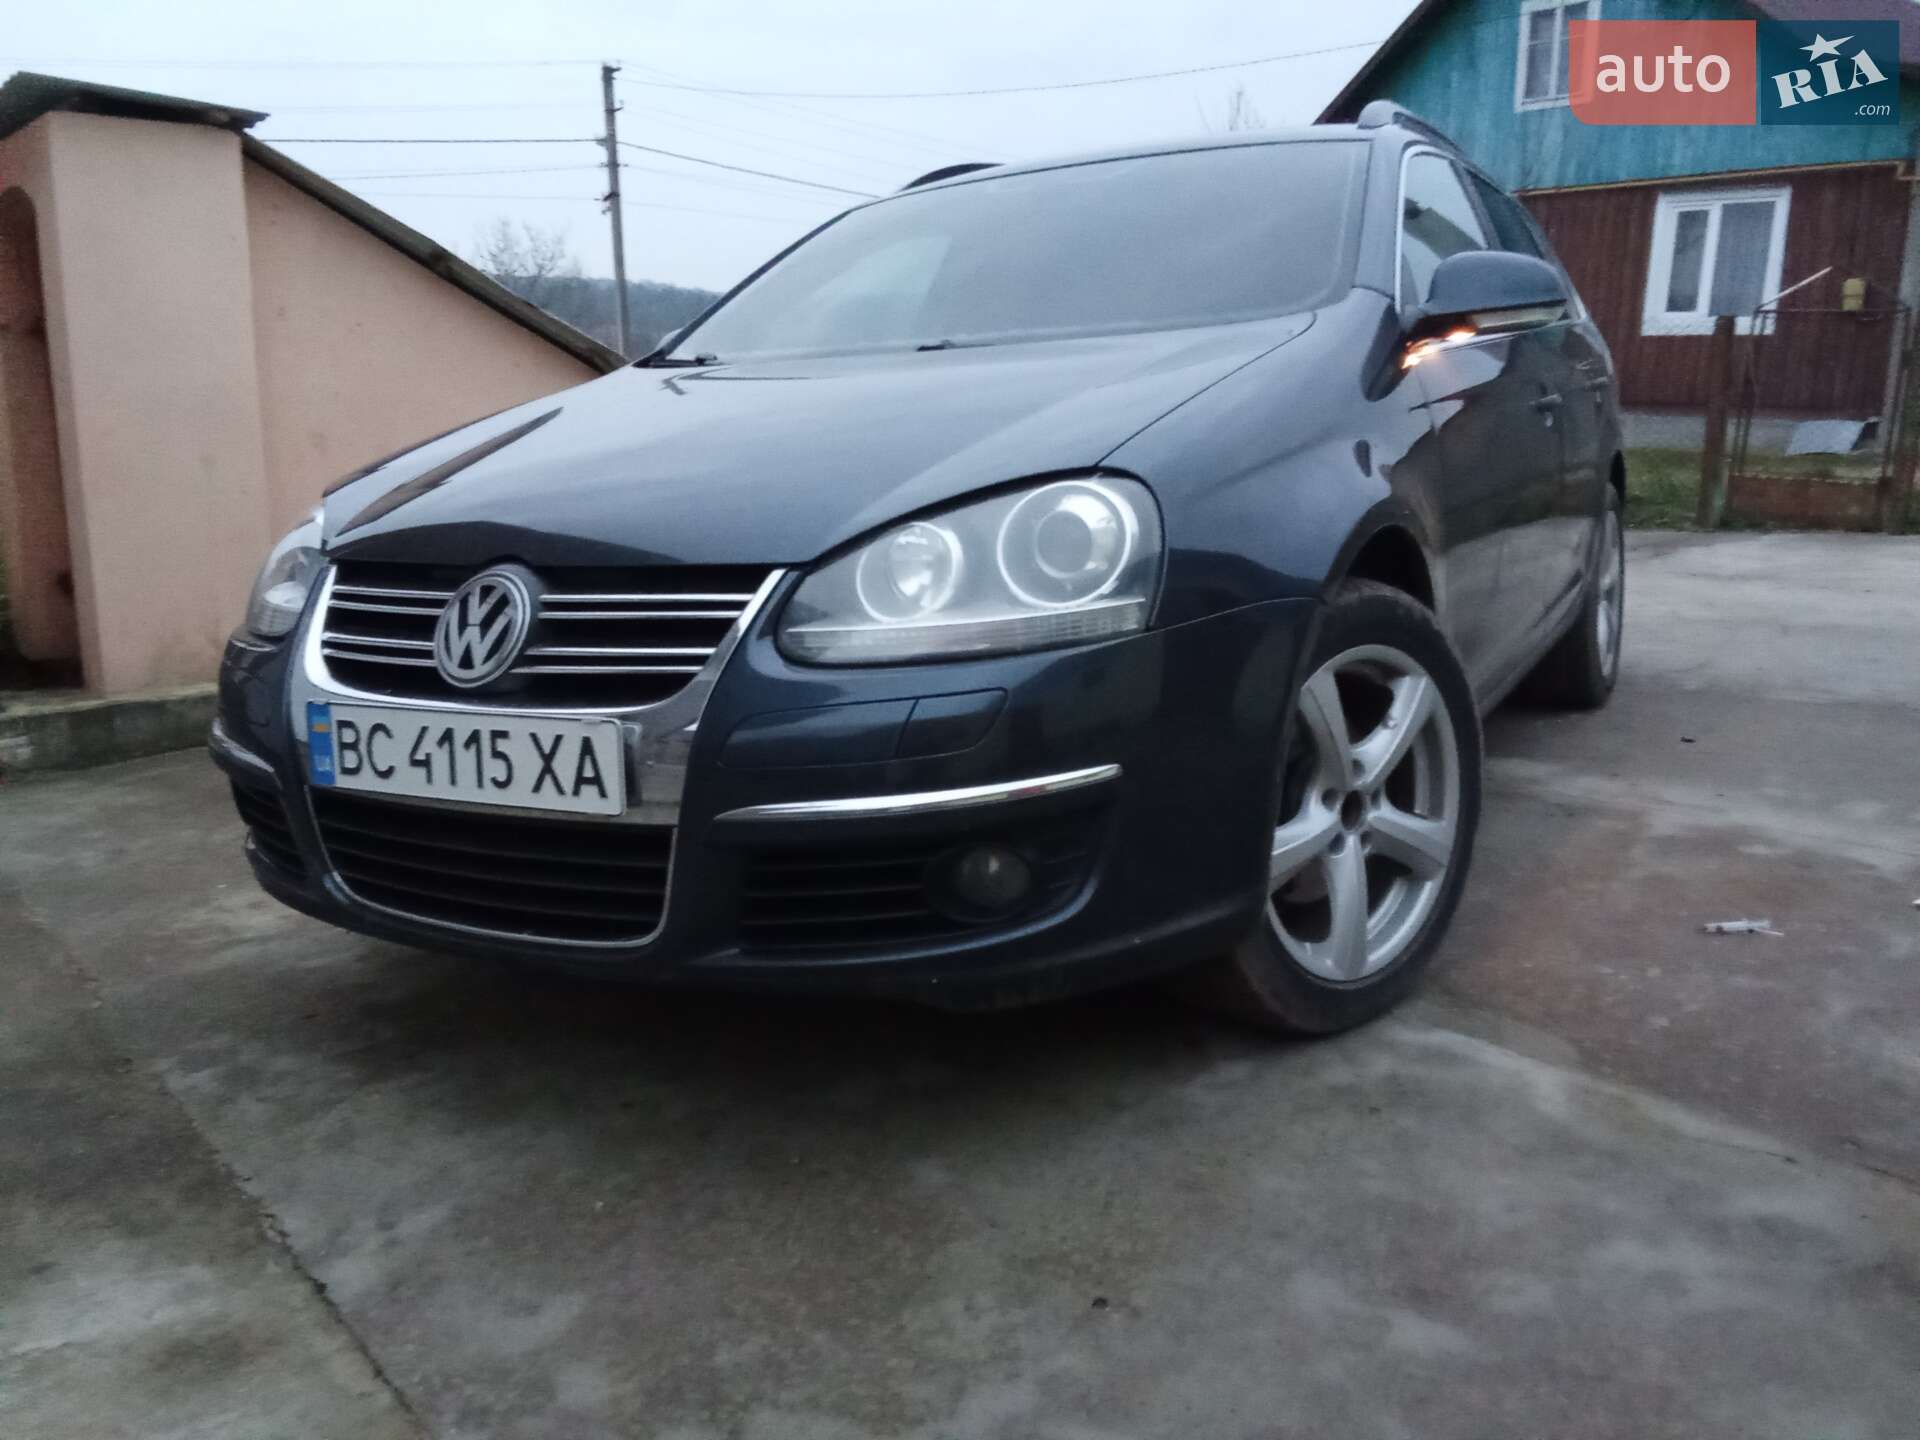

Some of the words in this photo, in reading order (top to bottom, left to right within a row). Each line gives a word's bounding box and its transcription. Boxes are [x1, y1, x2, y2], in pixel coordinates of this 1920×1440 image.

[336, 719, 396, 779] BC
[409, 725, 514, 790] 4115
[529, 732, 609, 799] XA
